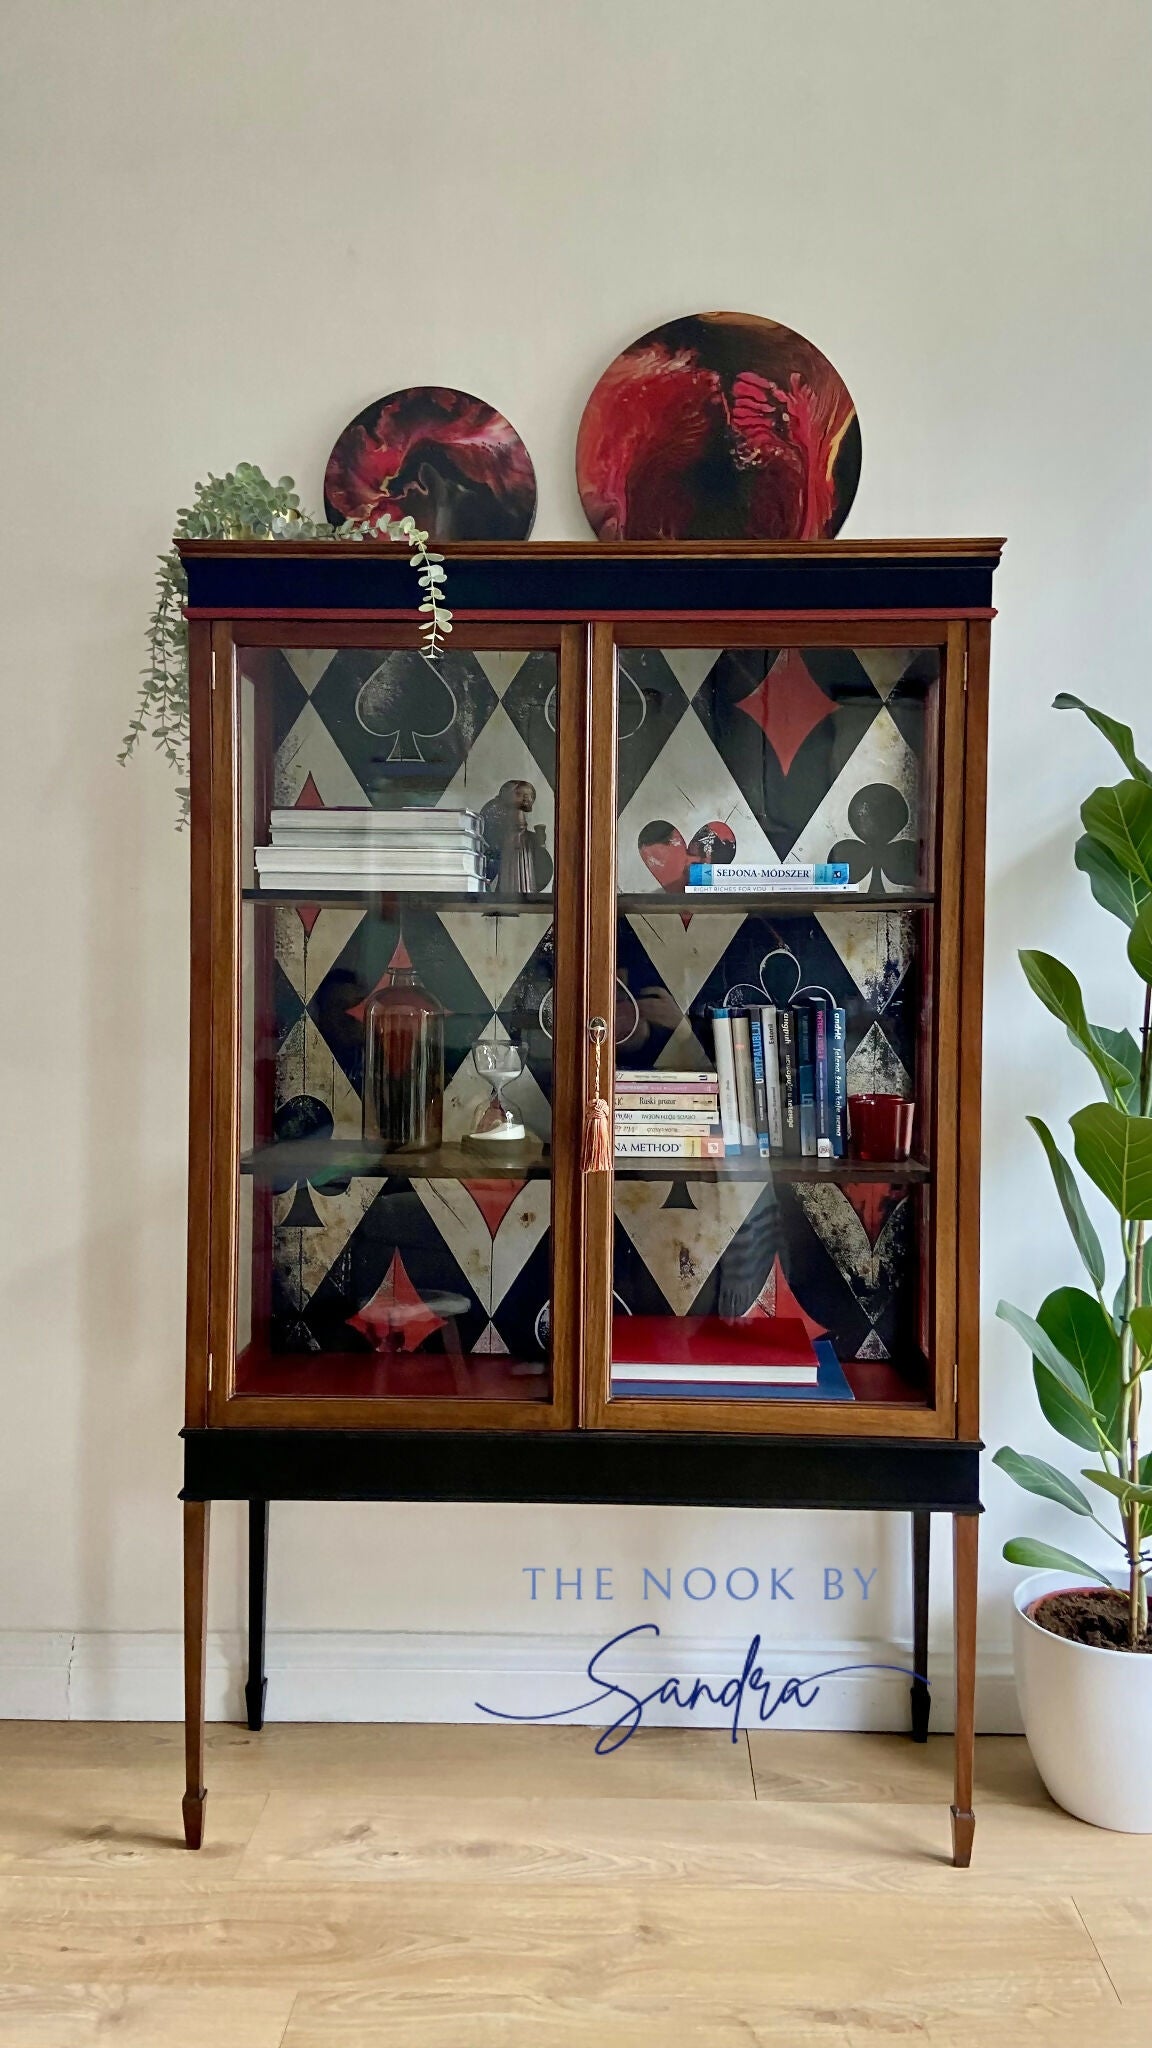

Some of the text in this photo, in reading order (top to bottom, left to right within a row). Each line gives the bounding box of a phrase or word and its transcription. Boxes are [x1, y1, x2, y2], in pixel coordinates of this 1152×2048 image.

[716, 868, 810, 879] SEDONA-MÓDSZER
[639, 1096, 656, 1105] Ruski
[630, 1143, 680, 1153] METHOD
